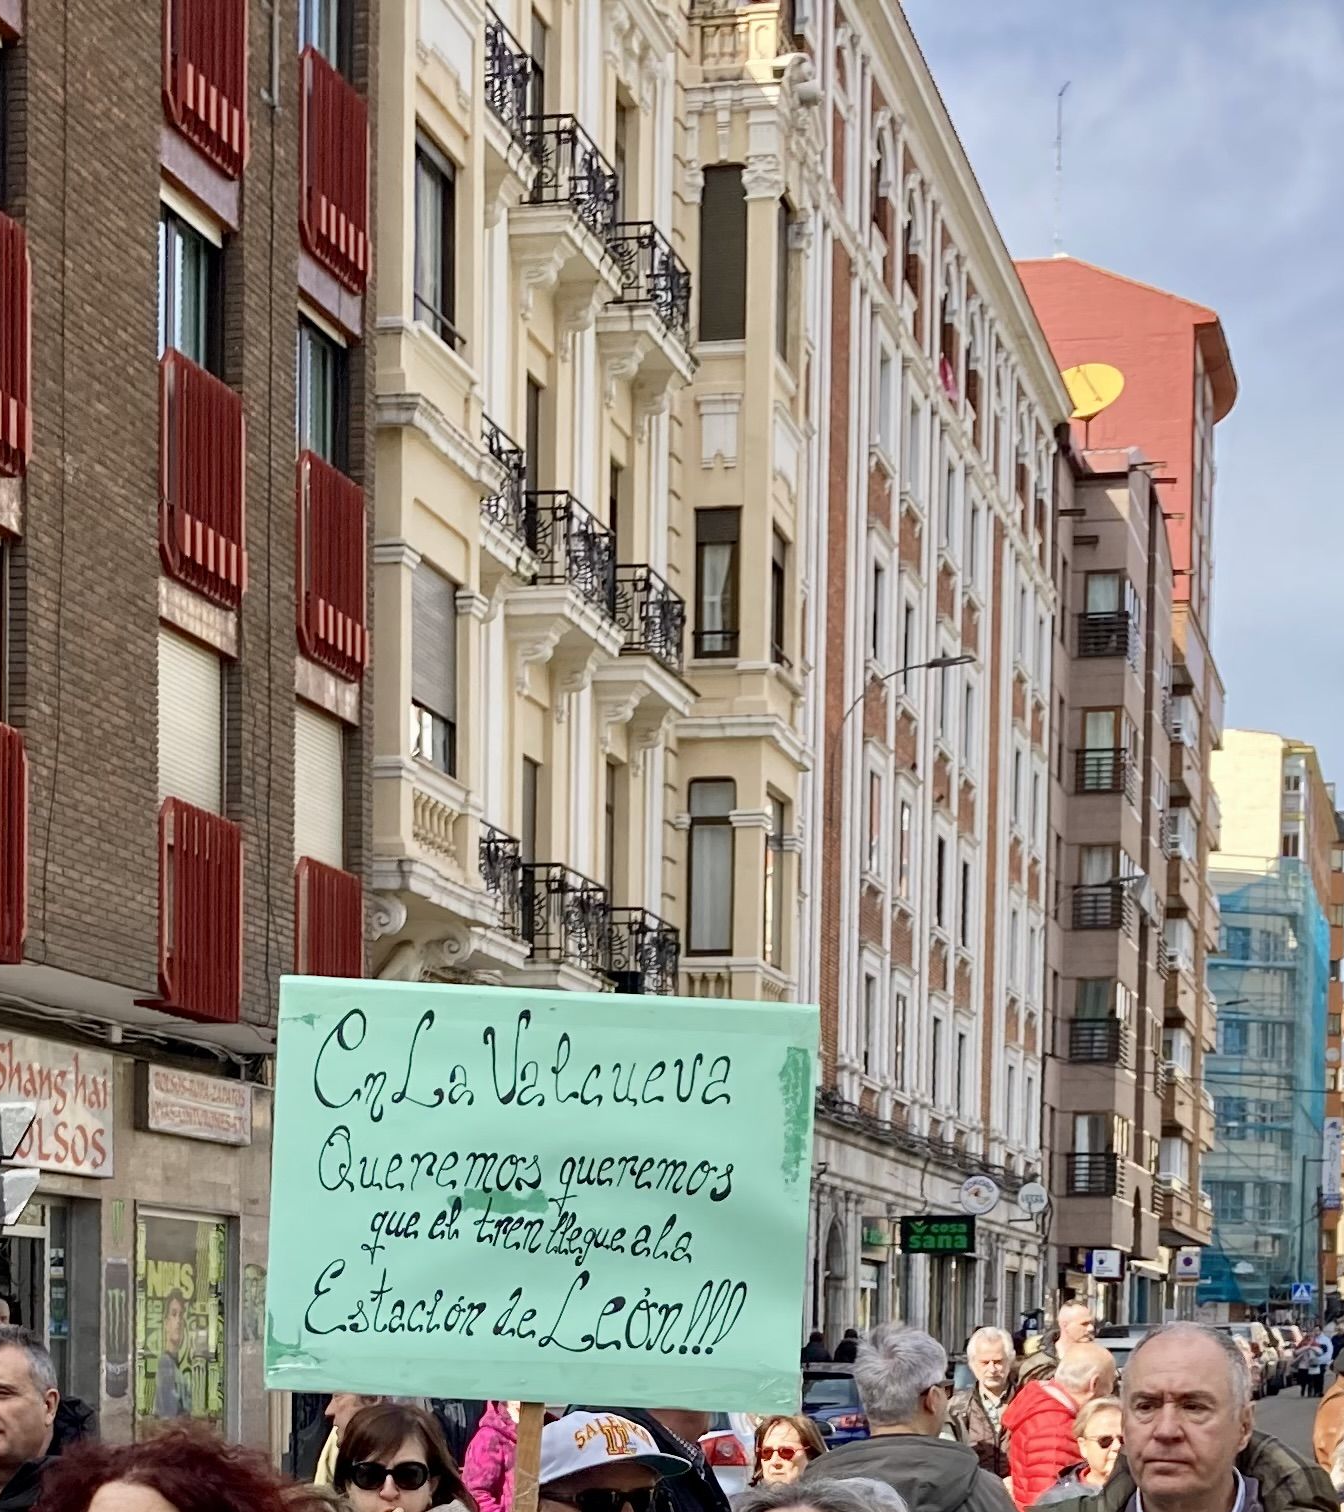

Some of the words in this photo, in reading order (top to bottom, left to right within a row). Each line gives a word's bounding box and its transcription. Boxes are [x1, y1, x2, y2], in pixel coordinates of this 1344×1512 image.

[74, 1052, 108, 1110] hai
[392, 1009, 474, 1108] La
[483, 1009, 731, 1107] Valcueva
[16, 1118, 105, 1168] OLSOS
[318, 1125, 541, 1192] Queremos
[548, 1152, 733, 1215] queremos
[361, 1209, 419, 1264] que
[428, 1196, 459, 1240] el
[473, 1197, 544, 1253] tren
[909, 1235, 968, 1248] sana
[930, 1222, 967, 1233] cosa
[304, 1259, 487, 1335] Estación
[493, 1288, 538, 1338] de
